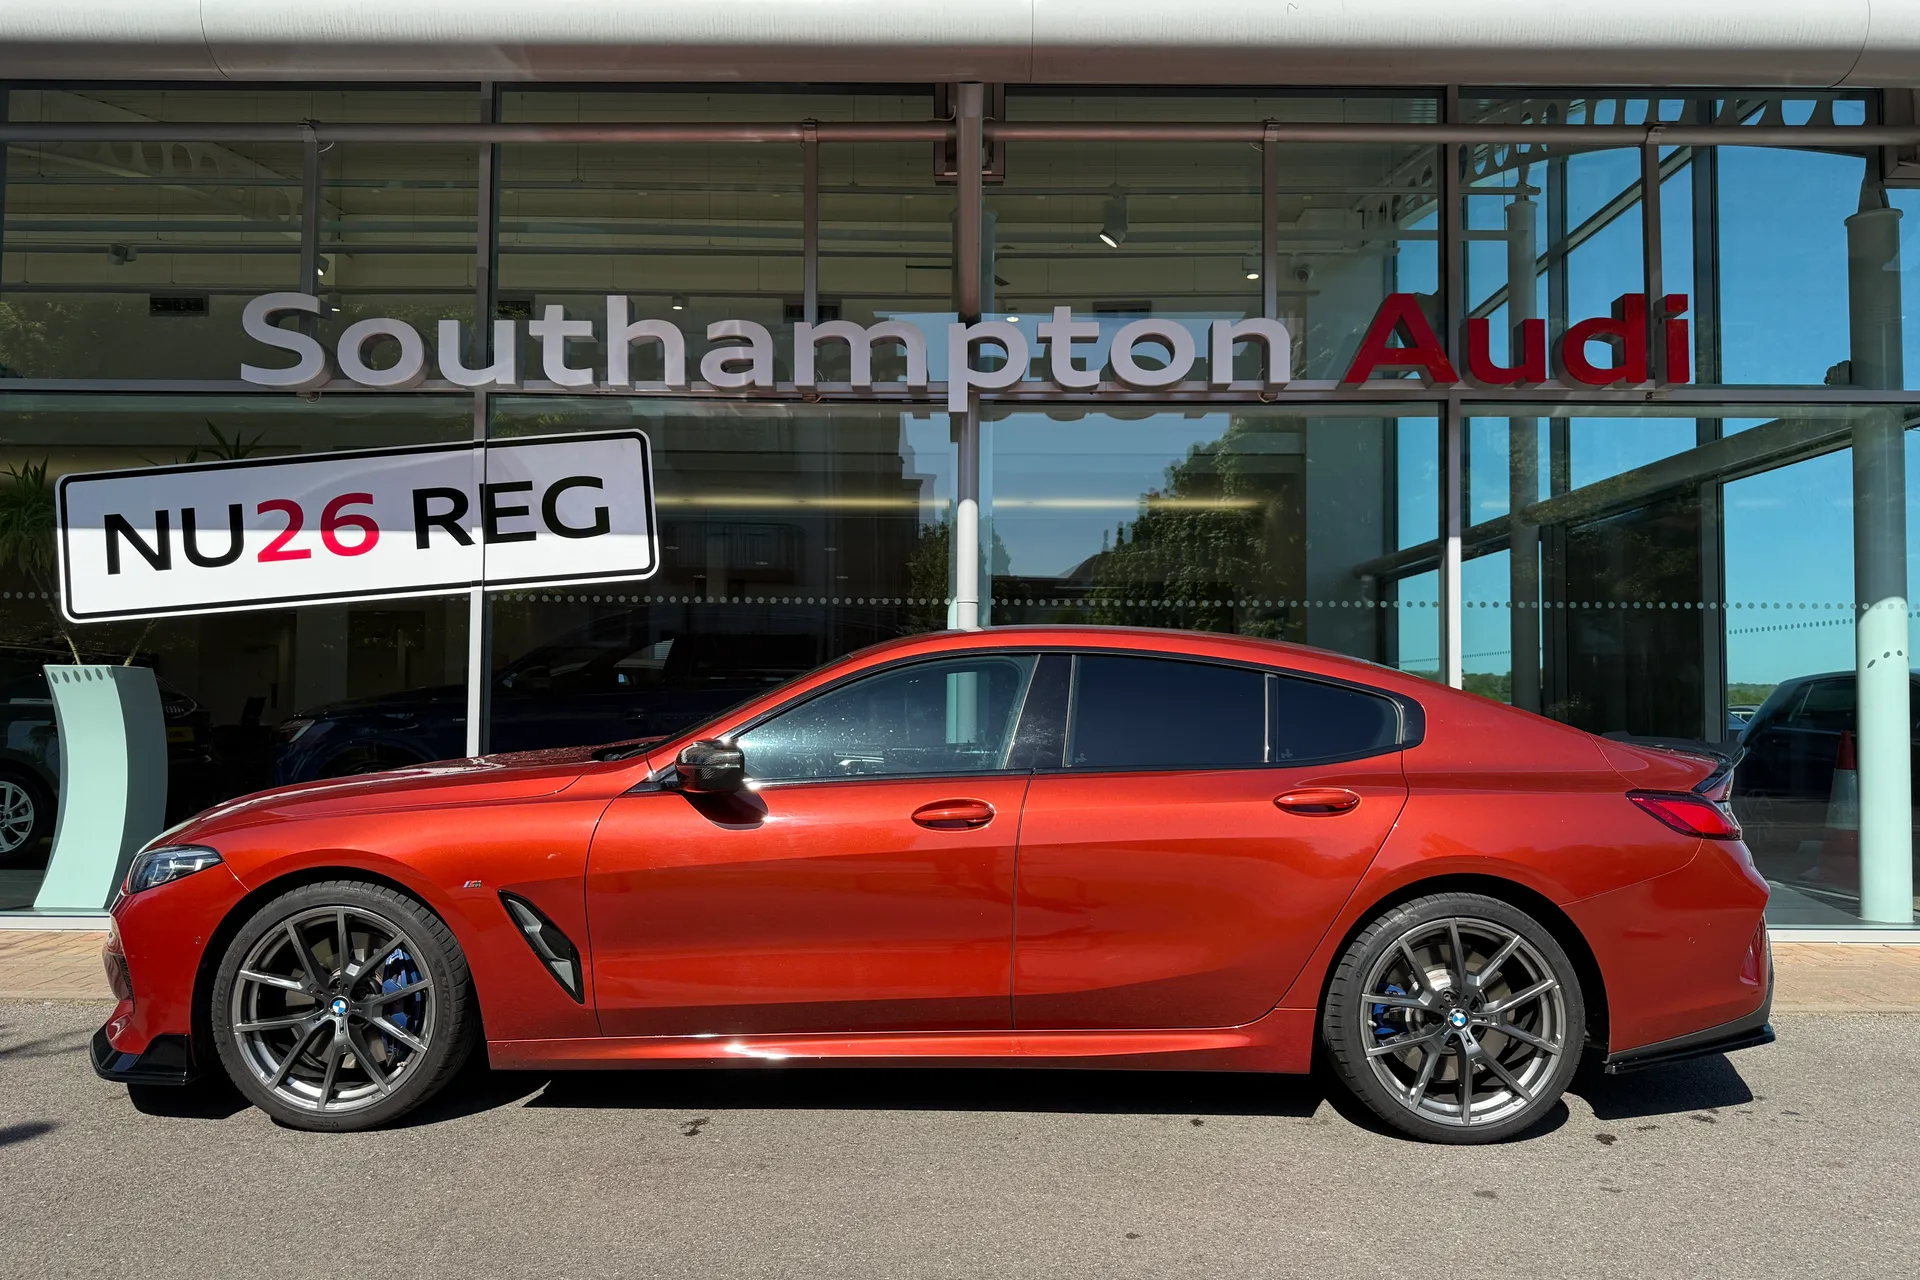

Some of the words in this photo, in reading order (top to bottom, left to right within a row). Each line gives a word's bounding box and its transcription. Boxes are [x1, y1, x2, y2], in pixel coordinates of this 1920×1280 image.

[241, 292, 1292, 413] Southampton
[1340, 292, 1690, 388] Audi
[104, 492, 380, 576] NU26
[412, 475, 611, 550] REG
